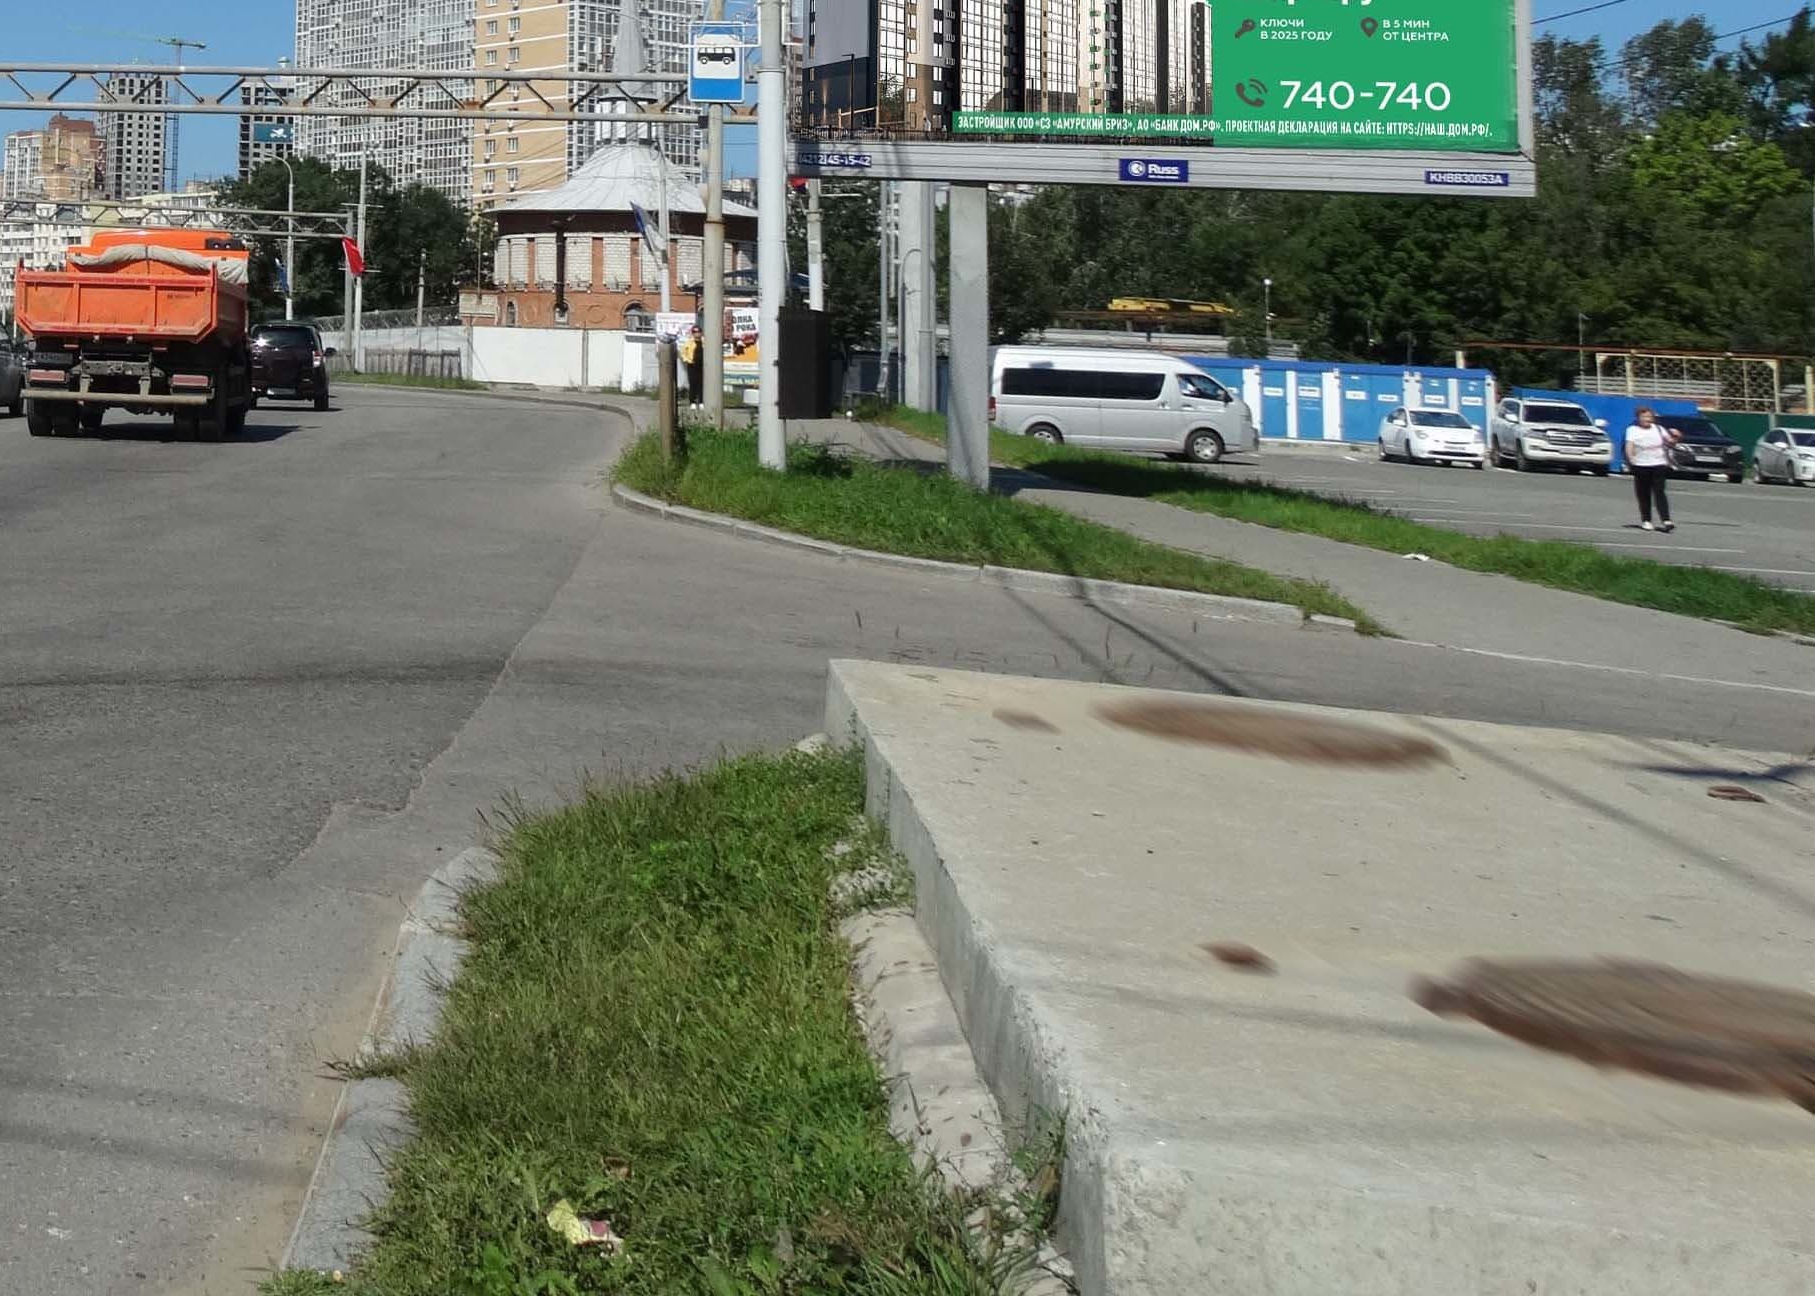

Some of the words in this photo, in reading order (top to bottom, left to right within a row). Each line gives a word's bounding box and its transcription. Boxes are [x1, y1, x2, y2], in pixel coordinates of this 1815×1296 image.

[1260, 18, 1304, 28] КЛЮЧИ
[1383, 19, 1391, 28] В
[1393, 19, 1400, 28] 5
[1403, 19, 1430, 28] МИН
[1260, 31, 1268, 40] В
[1271, 31, 1298, 40] 2025
[1301, 31, 1333, 41] ГОДУ
[1383, 31, 1398, 41] ОТ
[1401, 31, 1449, 42] ЦЕНТРА
[1279, 80, 1451, 110] 740-740
[957, 114, 1015, 130] ЗАСТРОЙЩИК
[1017, 116, 1034, 129] ООО
[1225, 120, 1275, 133] ПРОЕКТНАЯ
[1278, 121, 1338, 135] ДЕКЛАРАЦИЯ
[1340, 121, 1351, 134] НА
[1148, 163, 1179, 175] Russ
